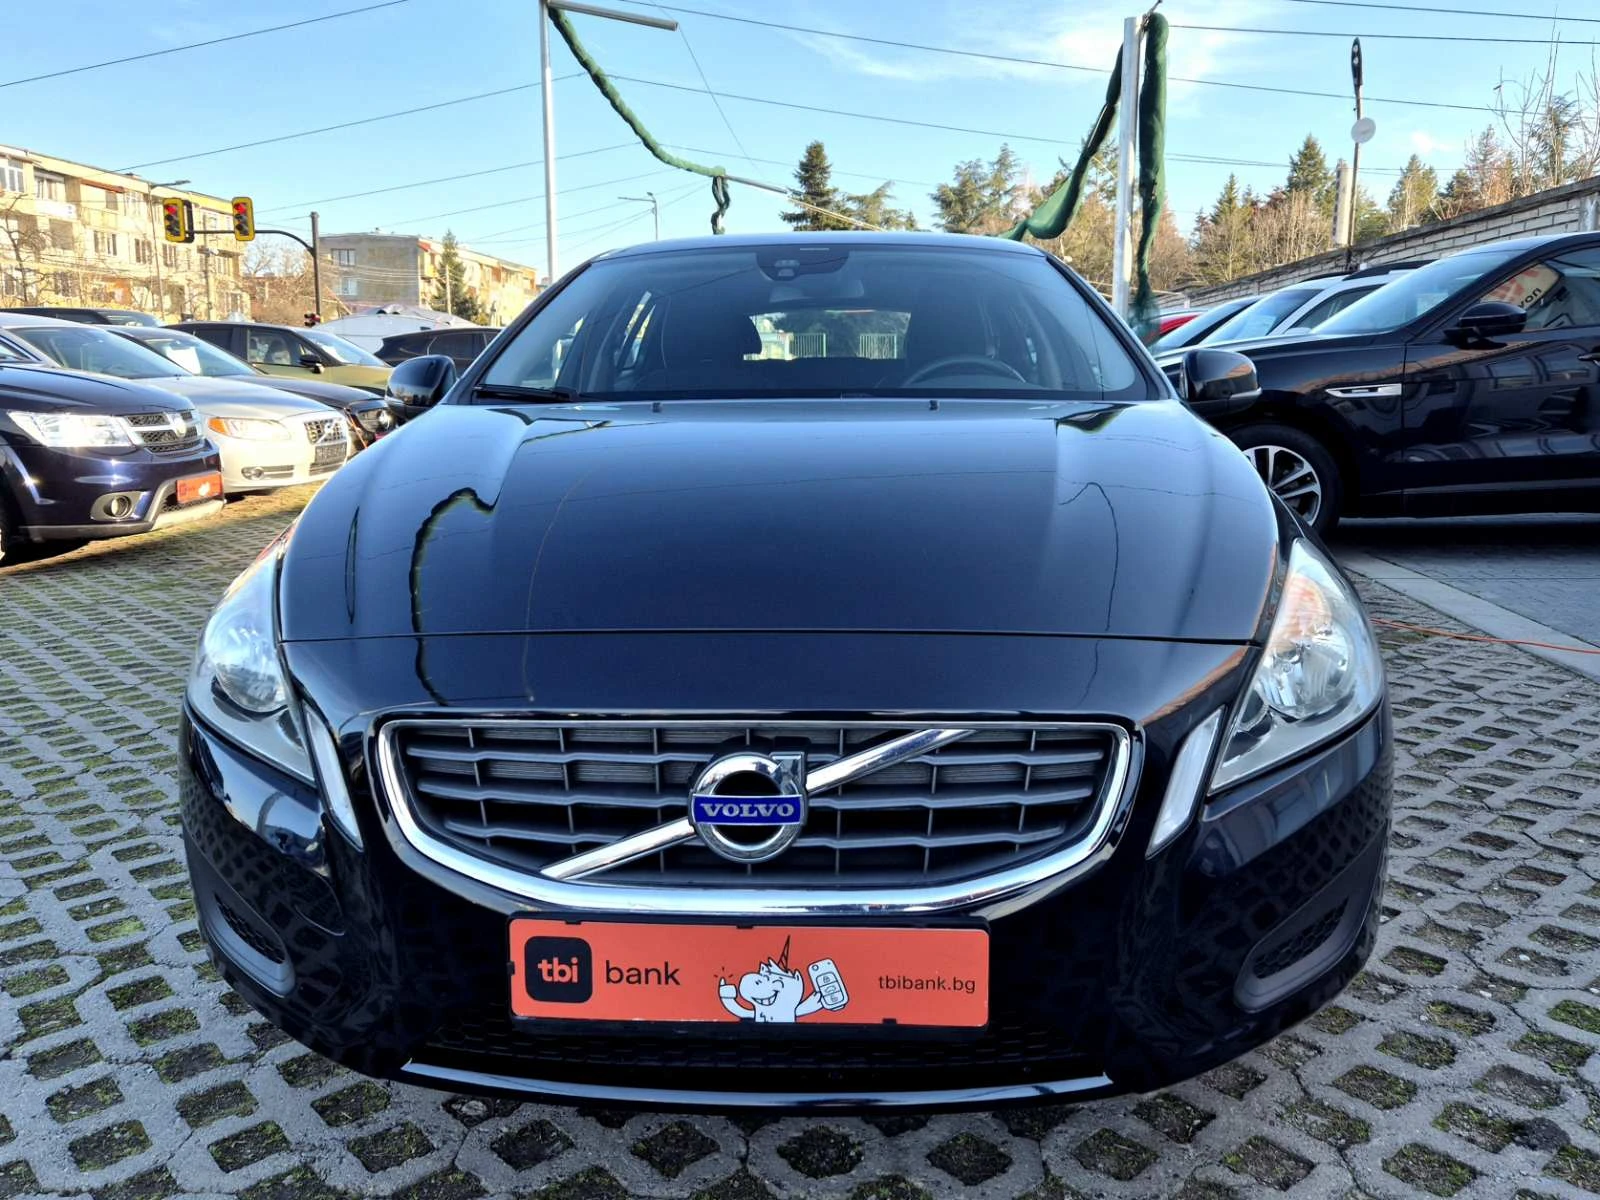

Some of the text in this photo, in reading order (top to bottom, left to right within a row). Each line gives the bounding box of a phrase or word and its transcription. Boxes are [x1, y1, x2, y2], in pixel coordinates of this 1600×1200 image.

[700, 803, 795, 817] VOLVO
[538, 957, 681, 986] tbi bank
[878, 975, 976, 994] tbibank.bg
